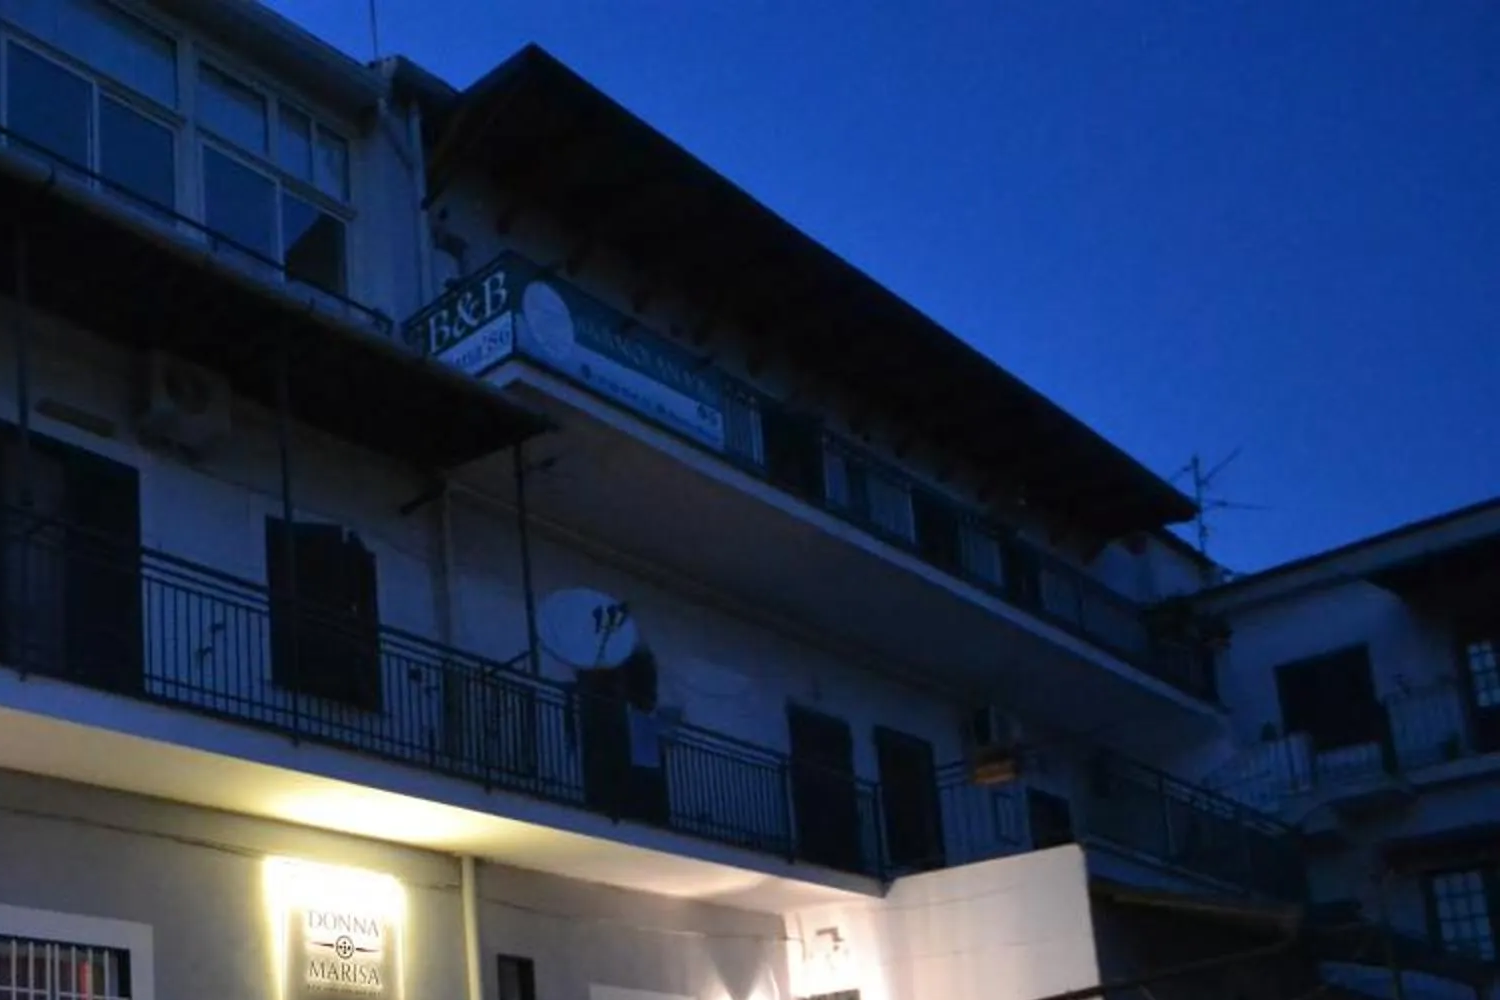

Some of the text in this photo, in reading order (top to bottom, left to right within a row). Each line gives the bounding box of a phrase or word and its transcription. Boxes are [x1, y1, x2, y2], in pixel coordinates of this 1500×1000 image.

[428, 270, 508, 354] B&B
[309, 910, 379, 937] DONNA
[309, 960, 380, 985] MARISA
